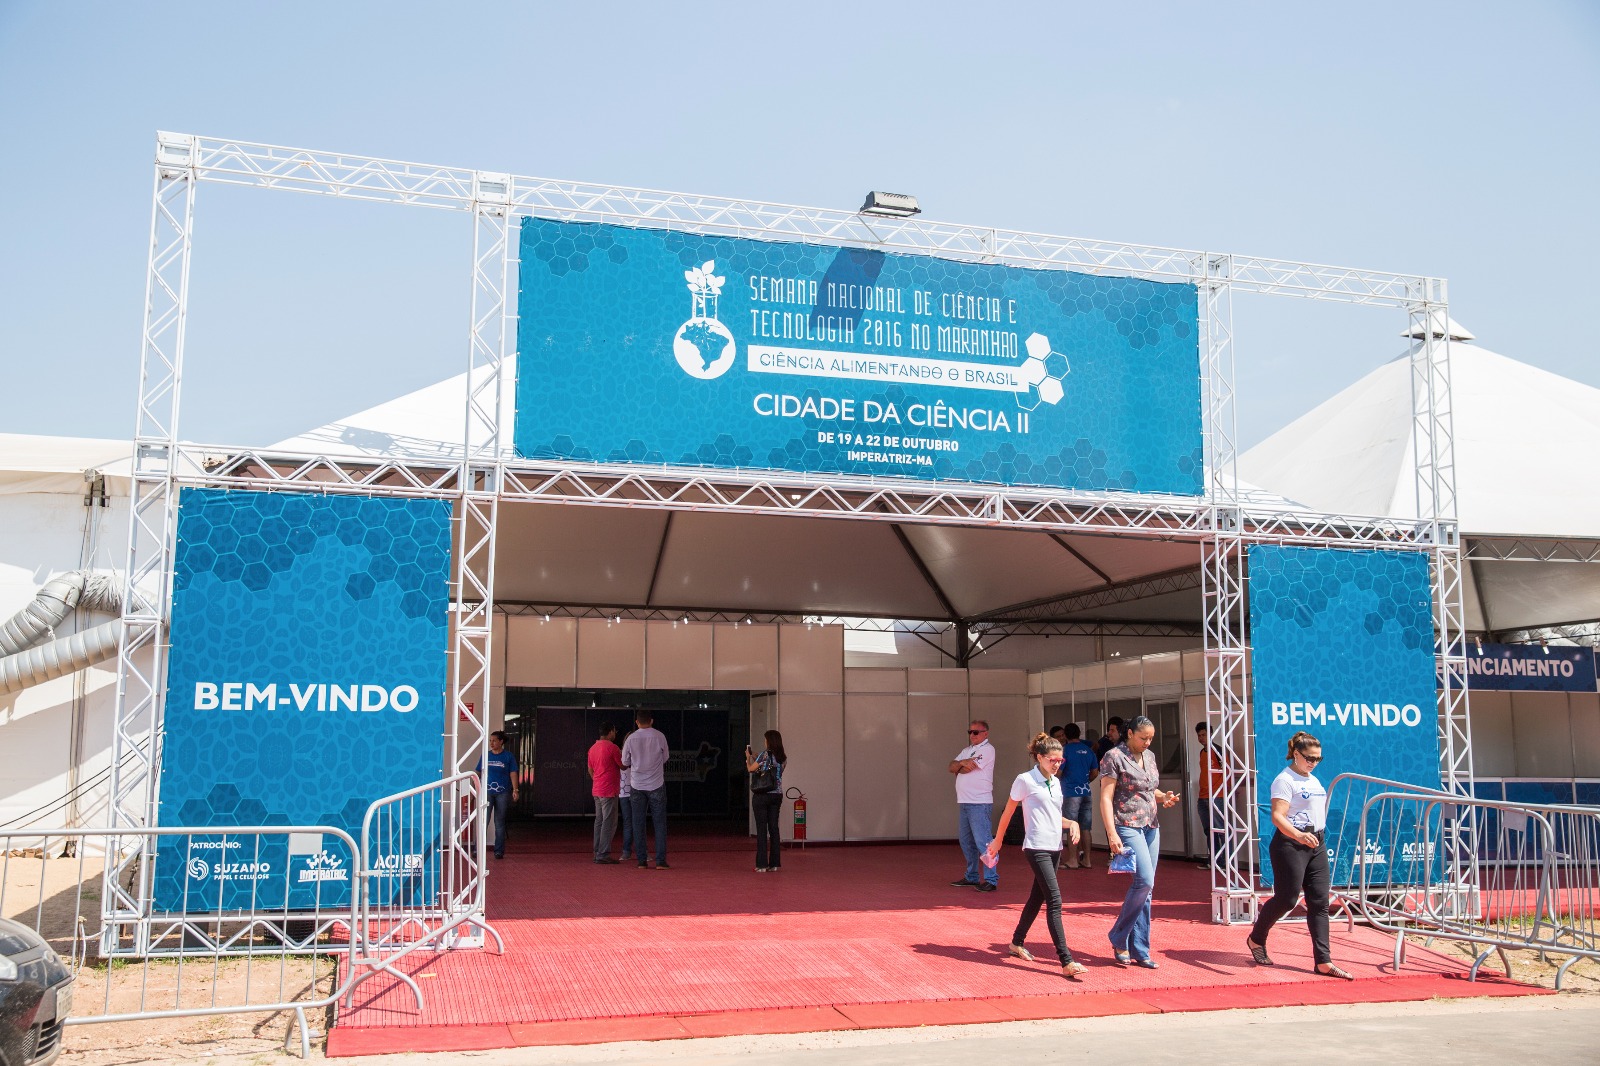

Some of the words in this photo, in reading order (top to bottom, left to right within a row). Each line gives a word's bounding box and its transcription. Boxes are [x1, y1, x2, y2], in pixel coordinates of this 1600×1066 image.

[749, 275, 818, 306] SEMANA
[828, 282, 905, 314] NACIONAL
[914, 290, 933, 317] DE
[942, 291, 1001, 322] CIÊNCIA
[1009, 299, 1017, 324] E
[750, 309, 854, 344] TECNOLOGIA
[864, 318, 902, 348] 2016
[911, 323, 931, 351] NO
[760, 352, 825, 371] CIÊNCIA
[830, 358, 943, 380] ALIMENTANDO
[948, 368, 959, 381] O
[965, 369, 1018, 386] BRASIL
[753, 392, 855, 422] CIDADE
[863, 400, 901, 424] DA
[907, 399, 1011, 433] CIÊNCIA
[1017, 412, 1029, 434] II
[817, 431, 835, 444] DE
[837, 432, 852, 445] 19
[854, 433, 864, 446] A
[865, 434, 881, 447] 22
[883, 435, 899, 448] DE
[902, 436, 959, 452] OUTUBRO
[847, 450, 933, 466] IMPERATRIZ-MA
[1435, 657, 1574, 678] EDENCIAMENTO
[194, 681, 419, 713] BEM-VINDO
[1271, 701, 1421, 727] BEM-VINDO
[213, 862, 271, 874] SUZANO
